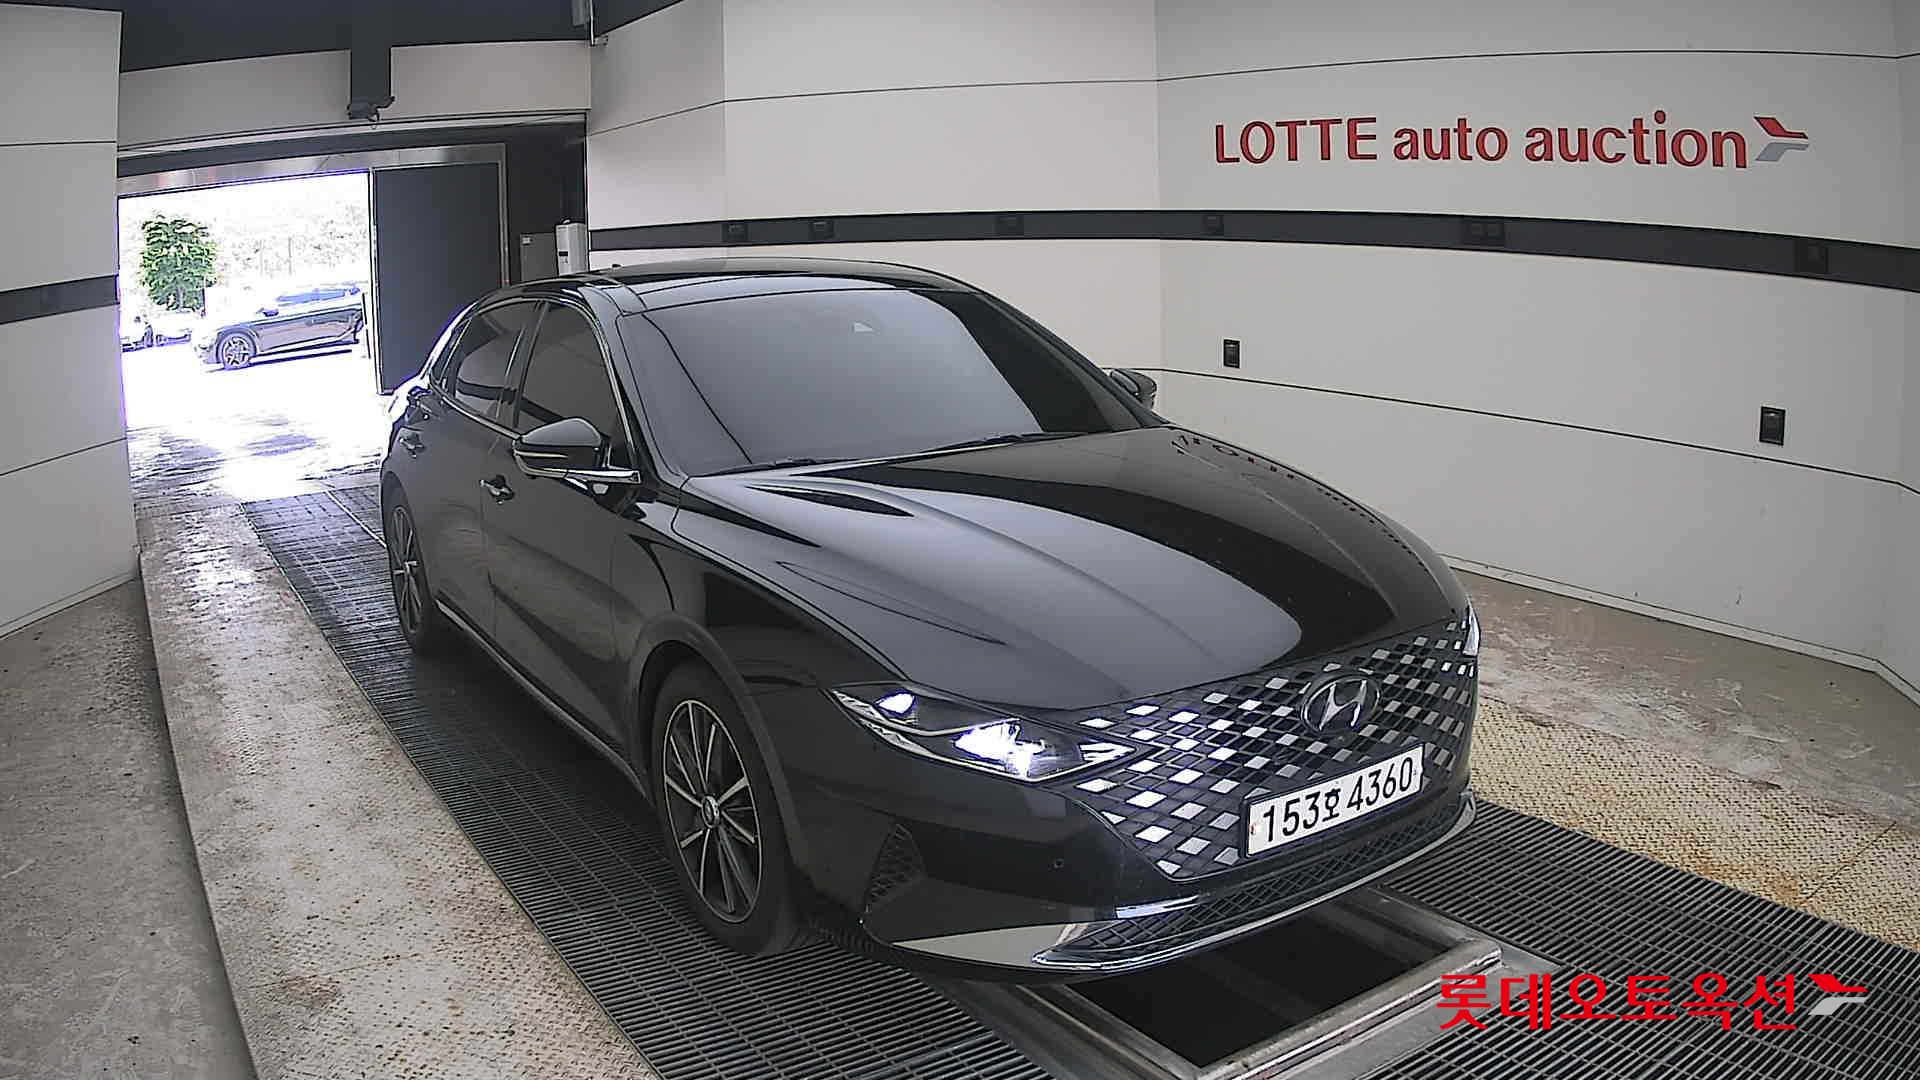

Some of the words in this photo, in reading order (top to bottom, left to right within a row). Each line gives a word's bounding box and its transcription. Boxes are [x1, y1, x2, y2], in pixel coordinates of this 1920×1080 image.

[1215, 116, 1377, 164] LOTTE
[1393, 117, 1509, 161] auto
[1525, 110, 1747, 169] auction
[1346, 757, 1413, 811] 4360
